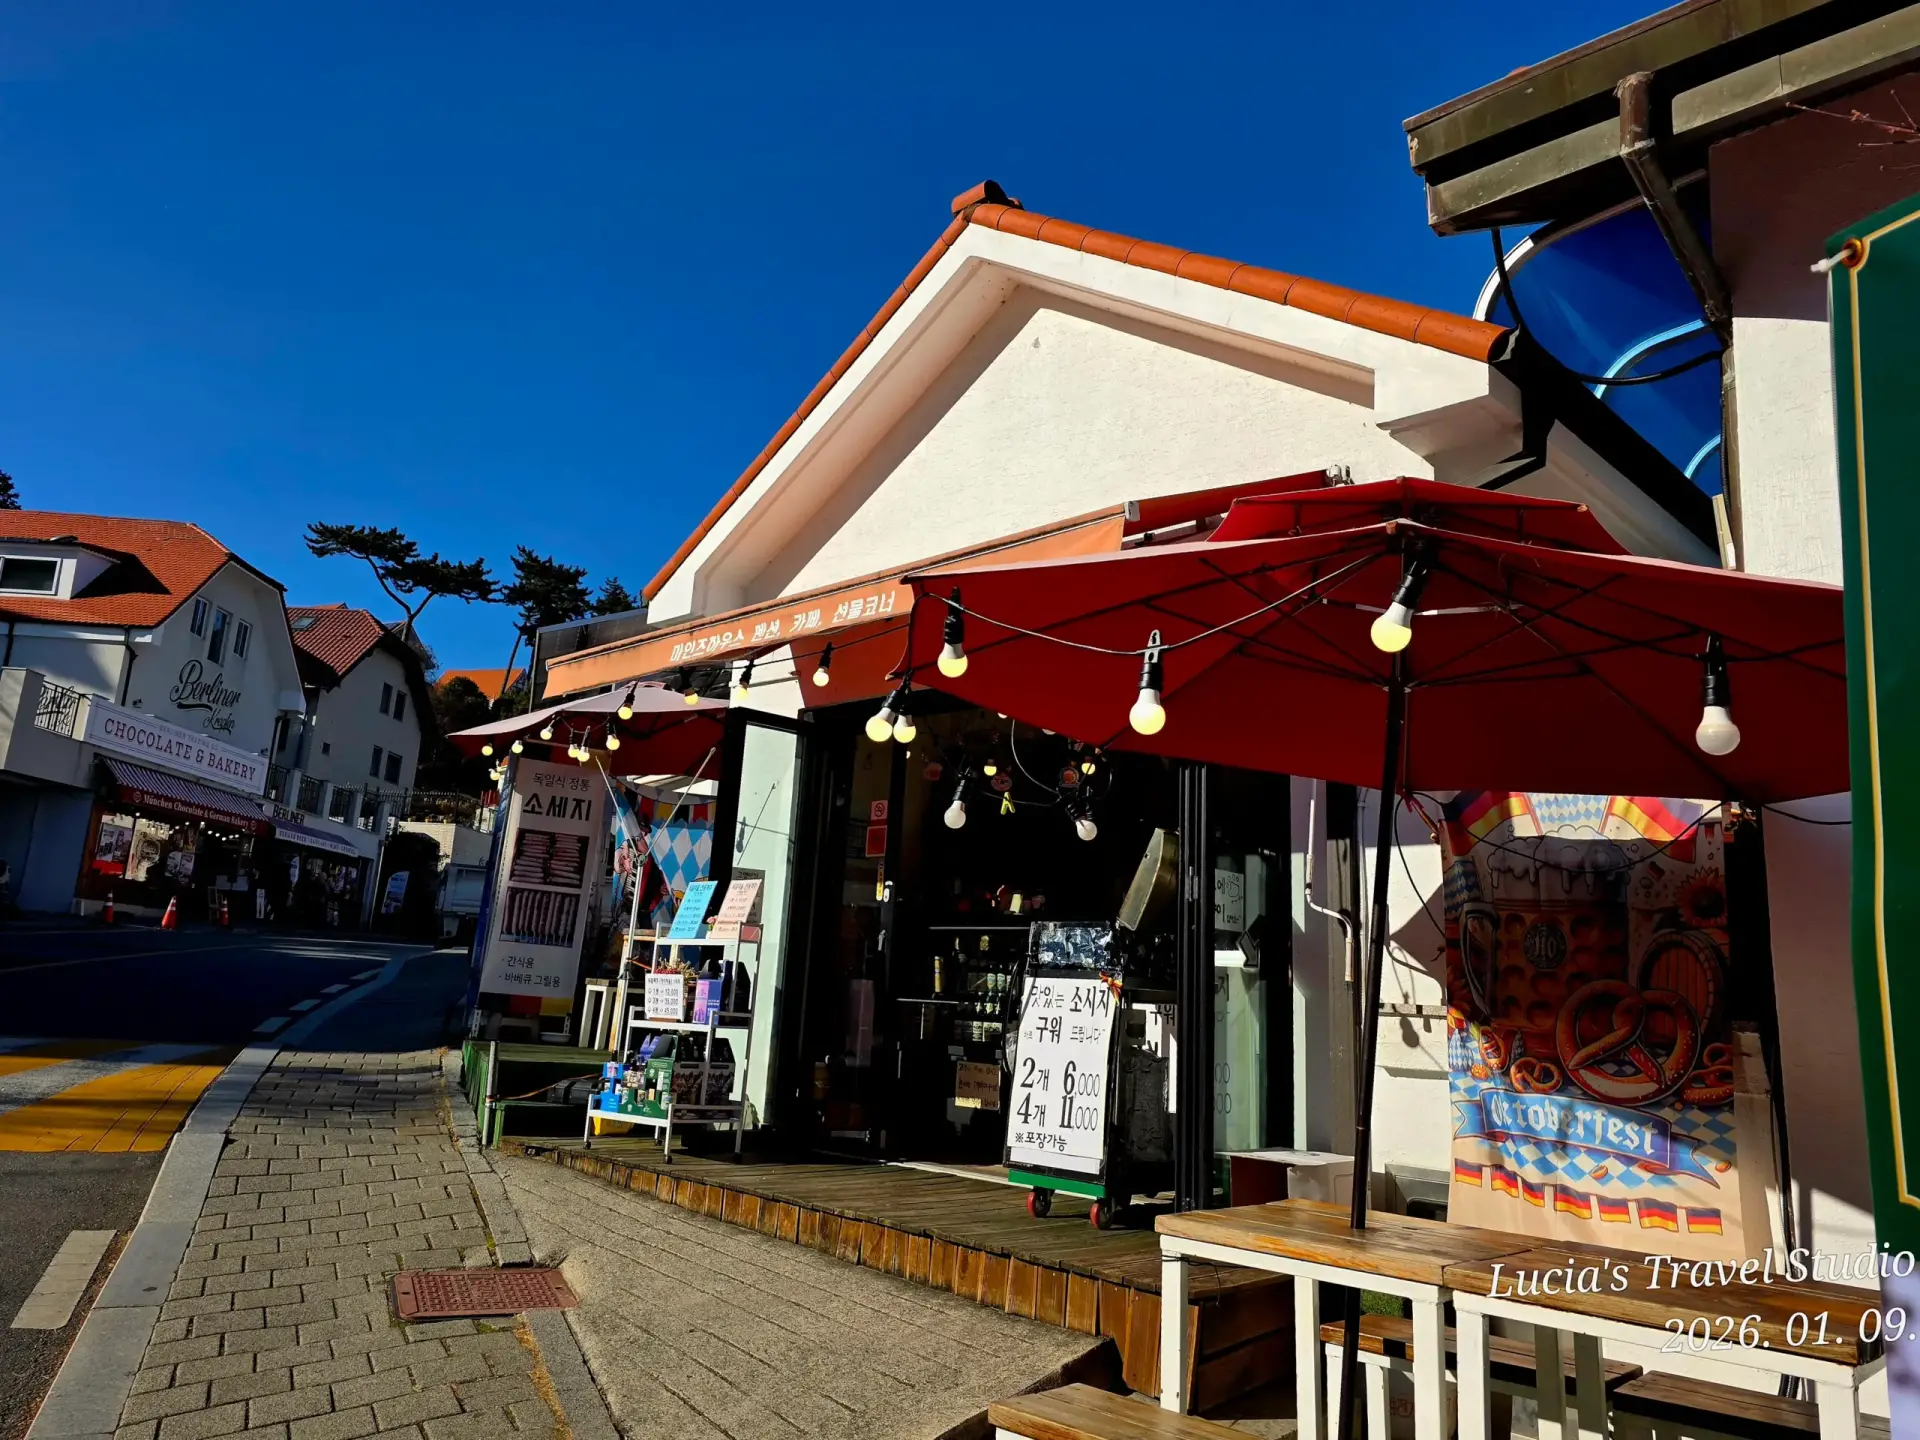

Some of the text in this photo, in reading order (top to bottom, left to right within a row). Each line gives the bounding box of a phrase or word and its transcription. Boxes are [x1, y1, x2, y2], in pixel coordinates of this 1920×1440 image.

[832, 591, 895, 624] 선물코너
[170, 659, 241, 707] Berliner
[104, 718, 257, 782] CHOCOLATE & BAKERY
[533, 772, 591, 792] 독일식 정통
[143, 794, 173, 810] München
[173, 802, 204, 817] Chocolate
[209, 810, 231, 823] German
[231, 815, 249, 829] Bakery
[274, 804, 304, 825] BERLINER
[522, 792, 592, 821] 소세지
[507, 956, 535, 969] 간식용
[504, 972, 561, 988] 바베큐 그릴용
[1030, 984, 1110, 1018] 맛있는 소시지
[1036, 1015, 1062, 1044] 구워
[1019, 1057, 1101, 1098] 2개 6,000
[1016, 1092, 1099, 1132] 4개 11,000
[1490, 1094, 1659, 1155] Oktoberfest
